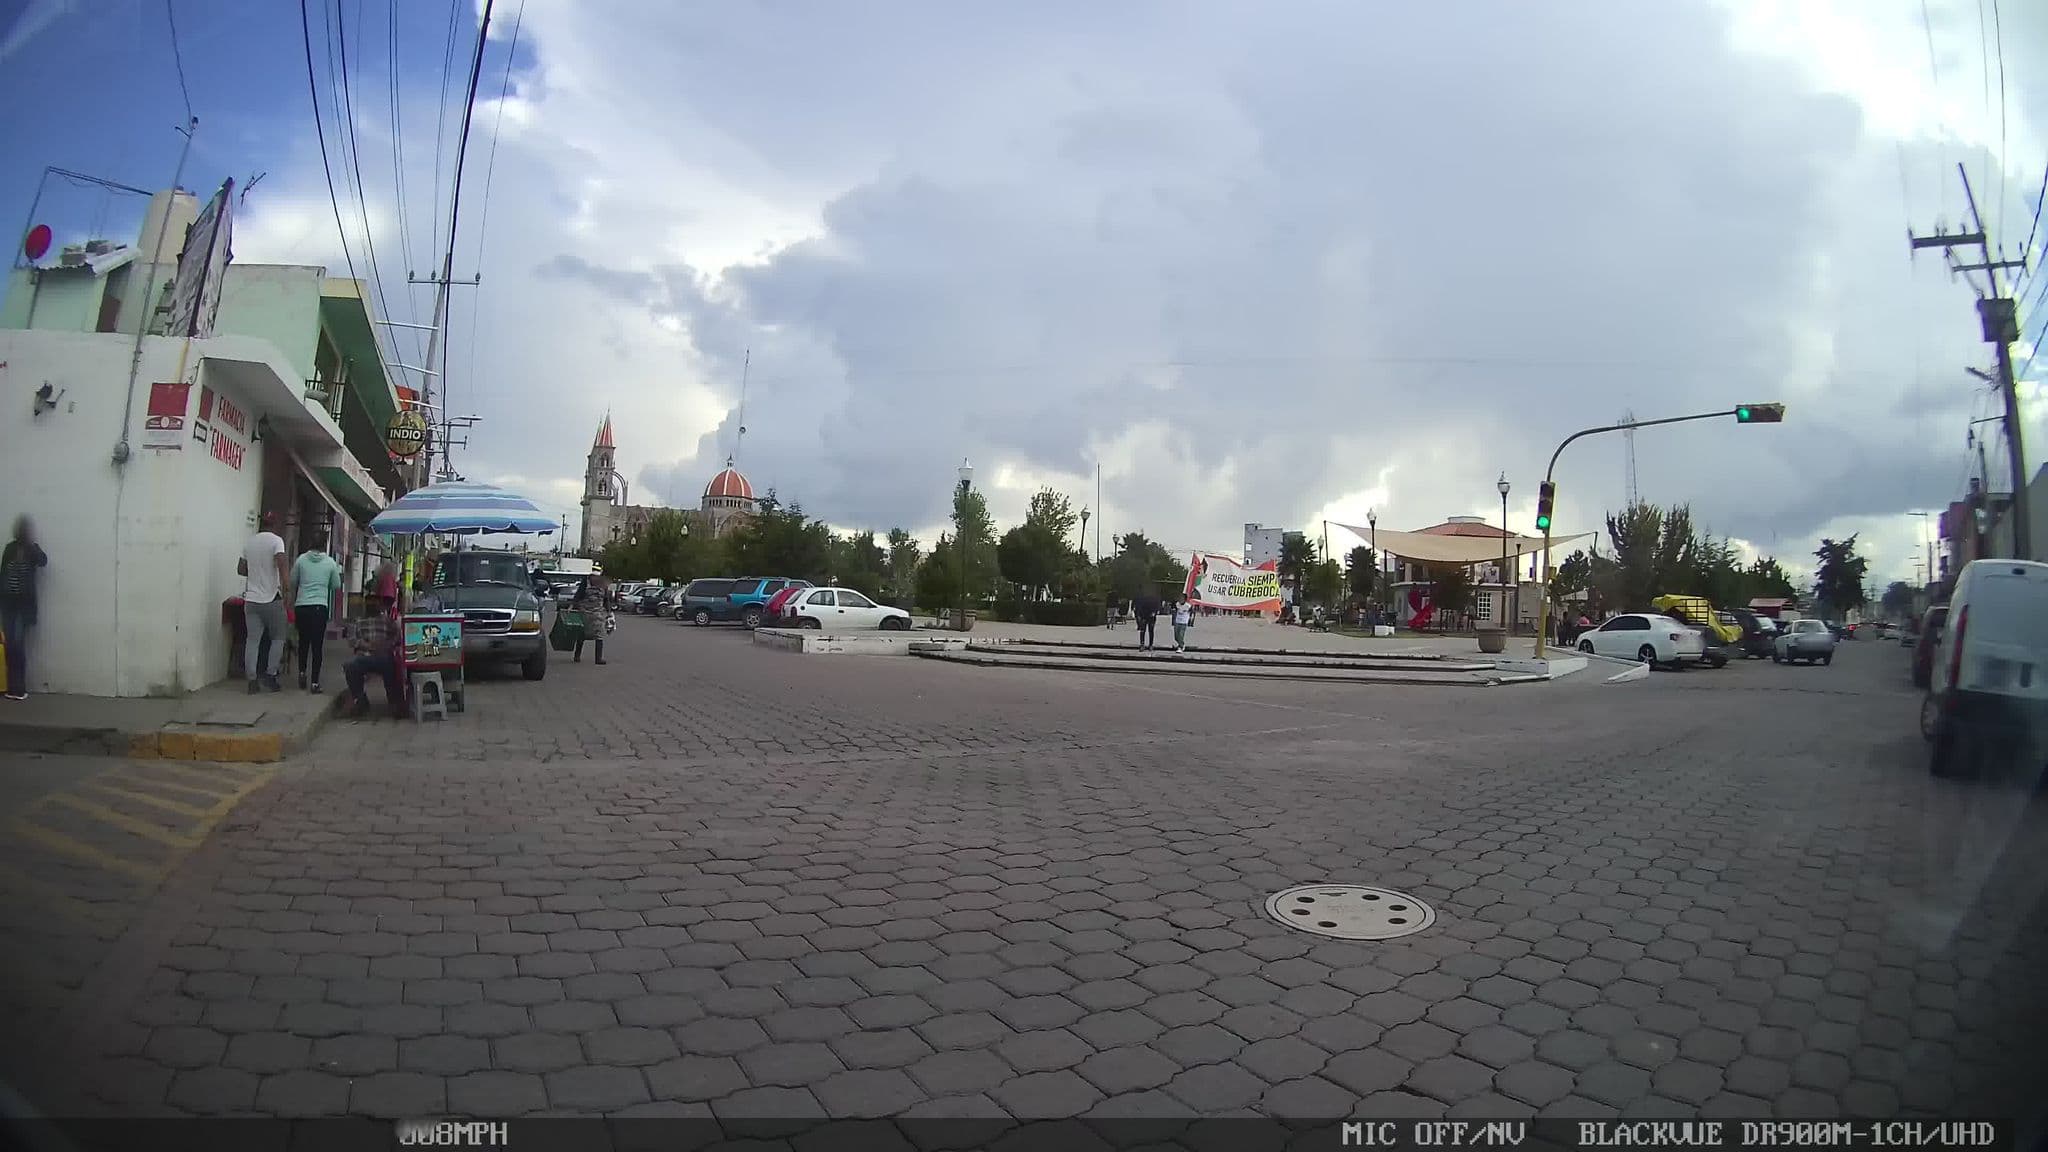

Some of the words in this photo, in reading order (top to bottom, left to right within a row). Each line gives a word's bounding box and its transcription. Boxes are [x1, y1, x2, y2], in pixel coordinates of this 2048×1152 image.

[218, 396, 245, 436] FARMACIA
[390, 428, 421, 440] INDIO
[1212, 573, 1245, 585] RECUERDA
[1248, 573, 1277, 586] SIEMP
[1208, 584, 1226, 596] USAR
